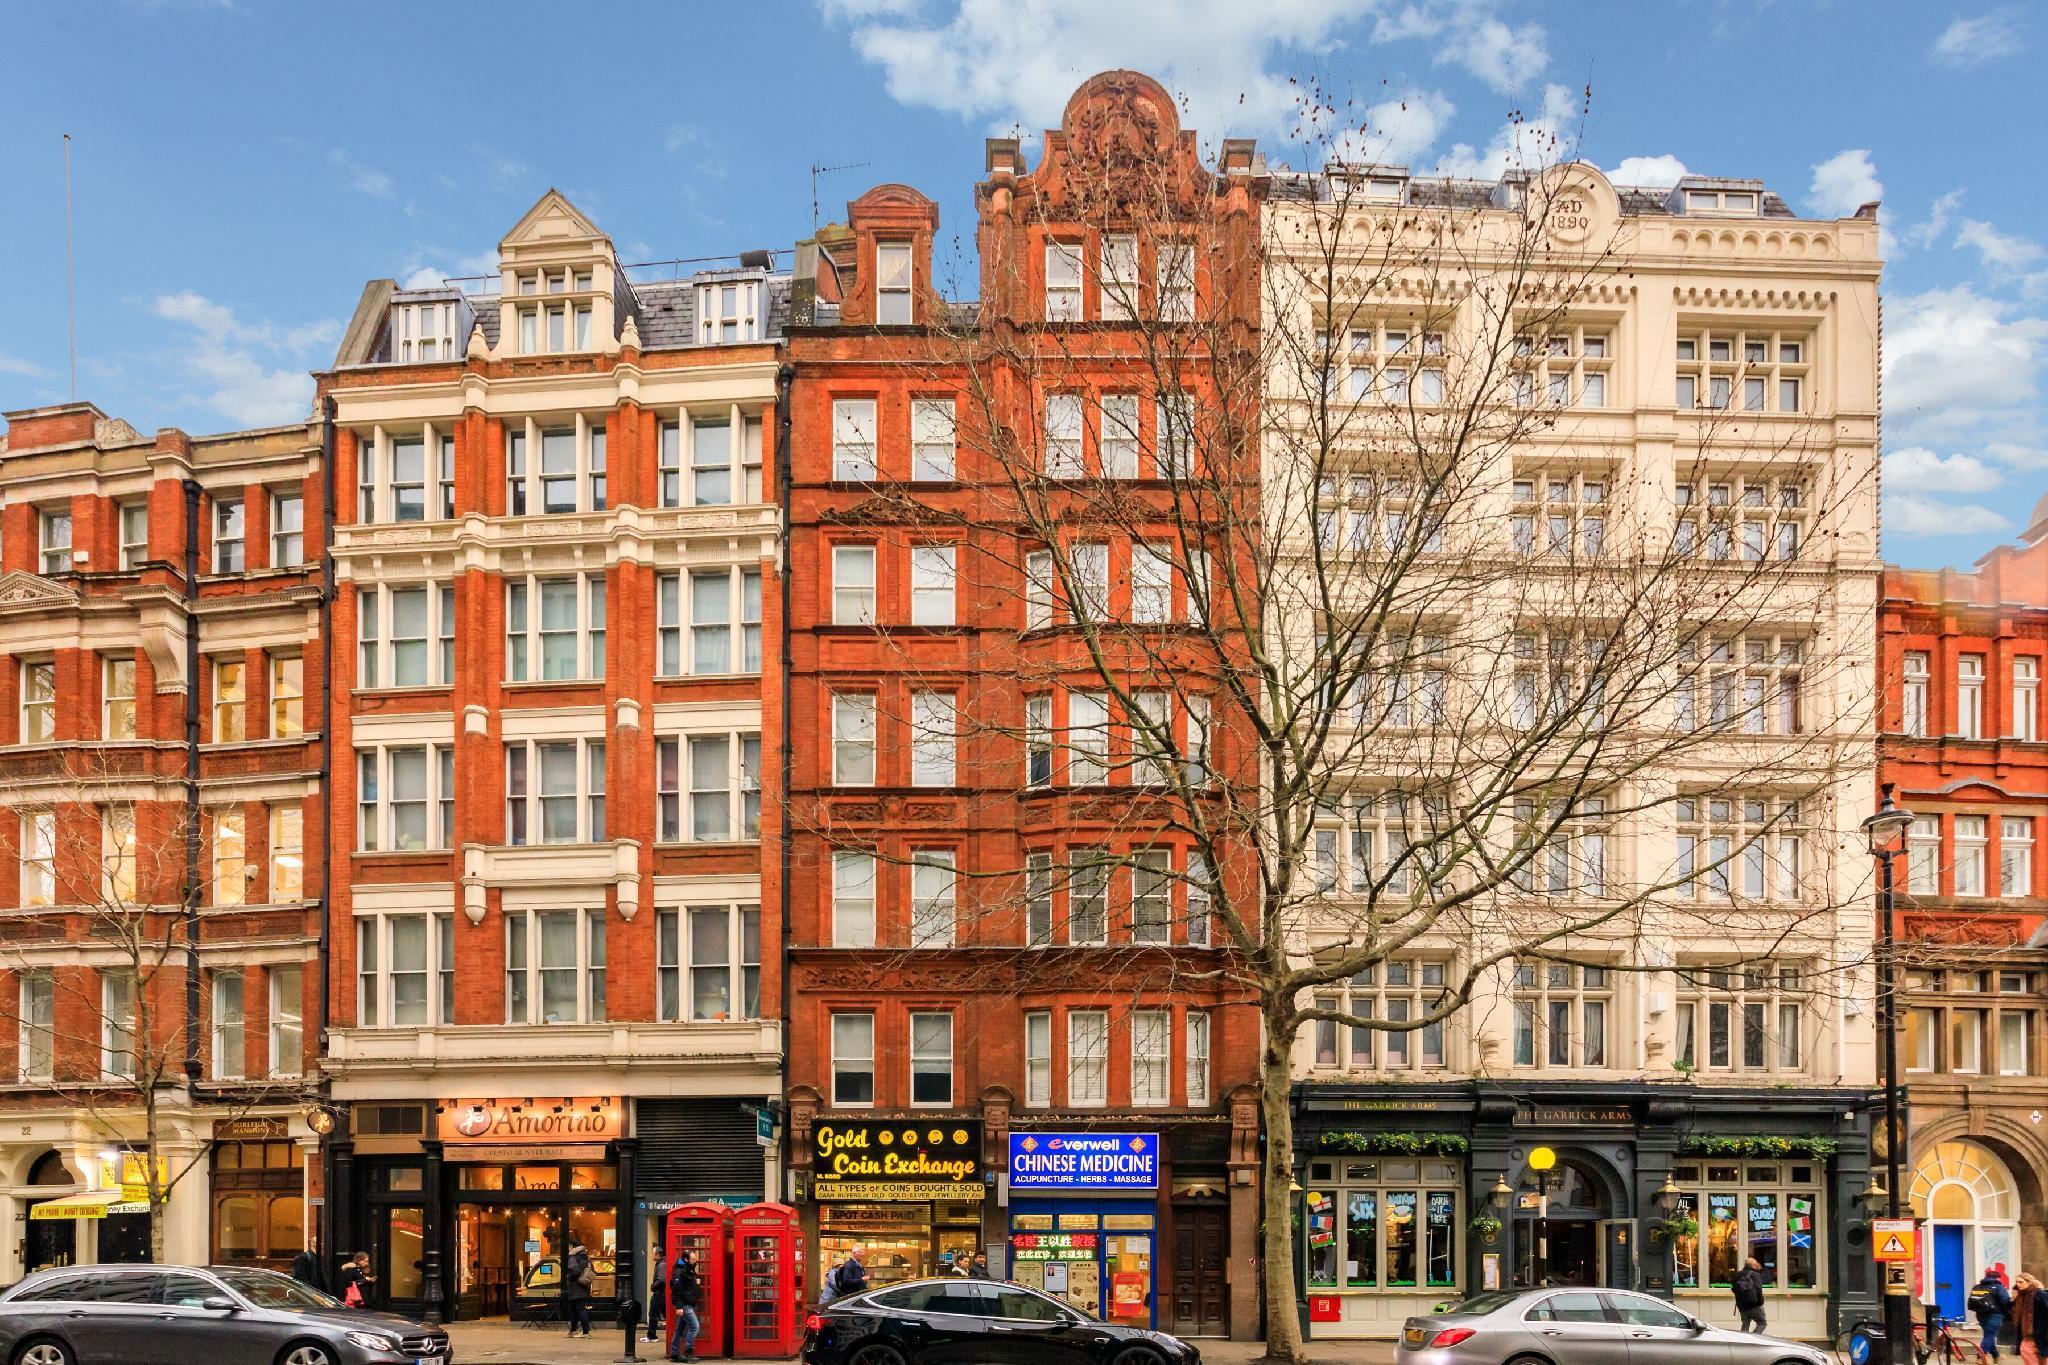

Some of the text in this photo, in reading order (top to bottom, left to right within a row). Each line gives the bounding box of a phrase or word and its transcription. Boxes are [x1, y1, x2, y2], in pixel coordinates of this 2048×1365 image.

[1552, 216, 1588, 229] 1890
[493, 1107, 606, 1134] Amorino
[1517, 1111, 1632, 1120] THE GARRICK ARMS
[22, 1127, 31, 1135] 22
[818, 1127, 871, 1157] Gold
[1048, 1139, 1120, 1151] everwell
[834, 1152, 975, 1181] Coin Exchange
[1014, 1154, 1153, 1172] CHINESE MEDICINE
[1015, 1175, 1073, 1183] ACUPUNCTURE
[1081, 1175, 1107, 1183] HERBS
[1114, 1175, 1152, 1183] MASSAGE
[654, 1202, 674, 1210] Faraday
[1431, 1197, 1449, 1206] CATCH
[1710, 1196, 1736, 1207] WATCH
[46, 1207, 59, 1216] PHONE
[64, 1206, 78, 1216] MONEY
[79, 1205, 99, 1215] EXCHANGE
[832, 1211, 914, 1219] SPOT CASH PAID
[1349, 1201, 1376, 1222] SIX
[1749, 1207, 1776, 1221] RUGBY
